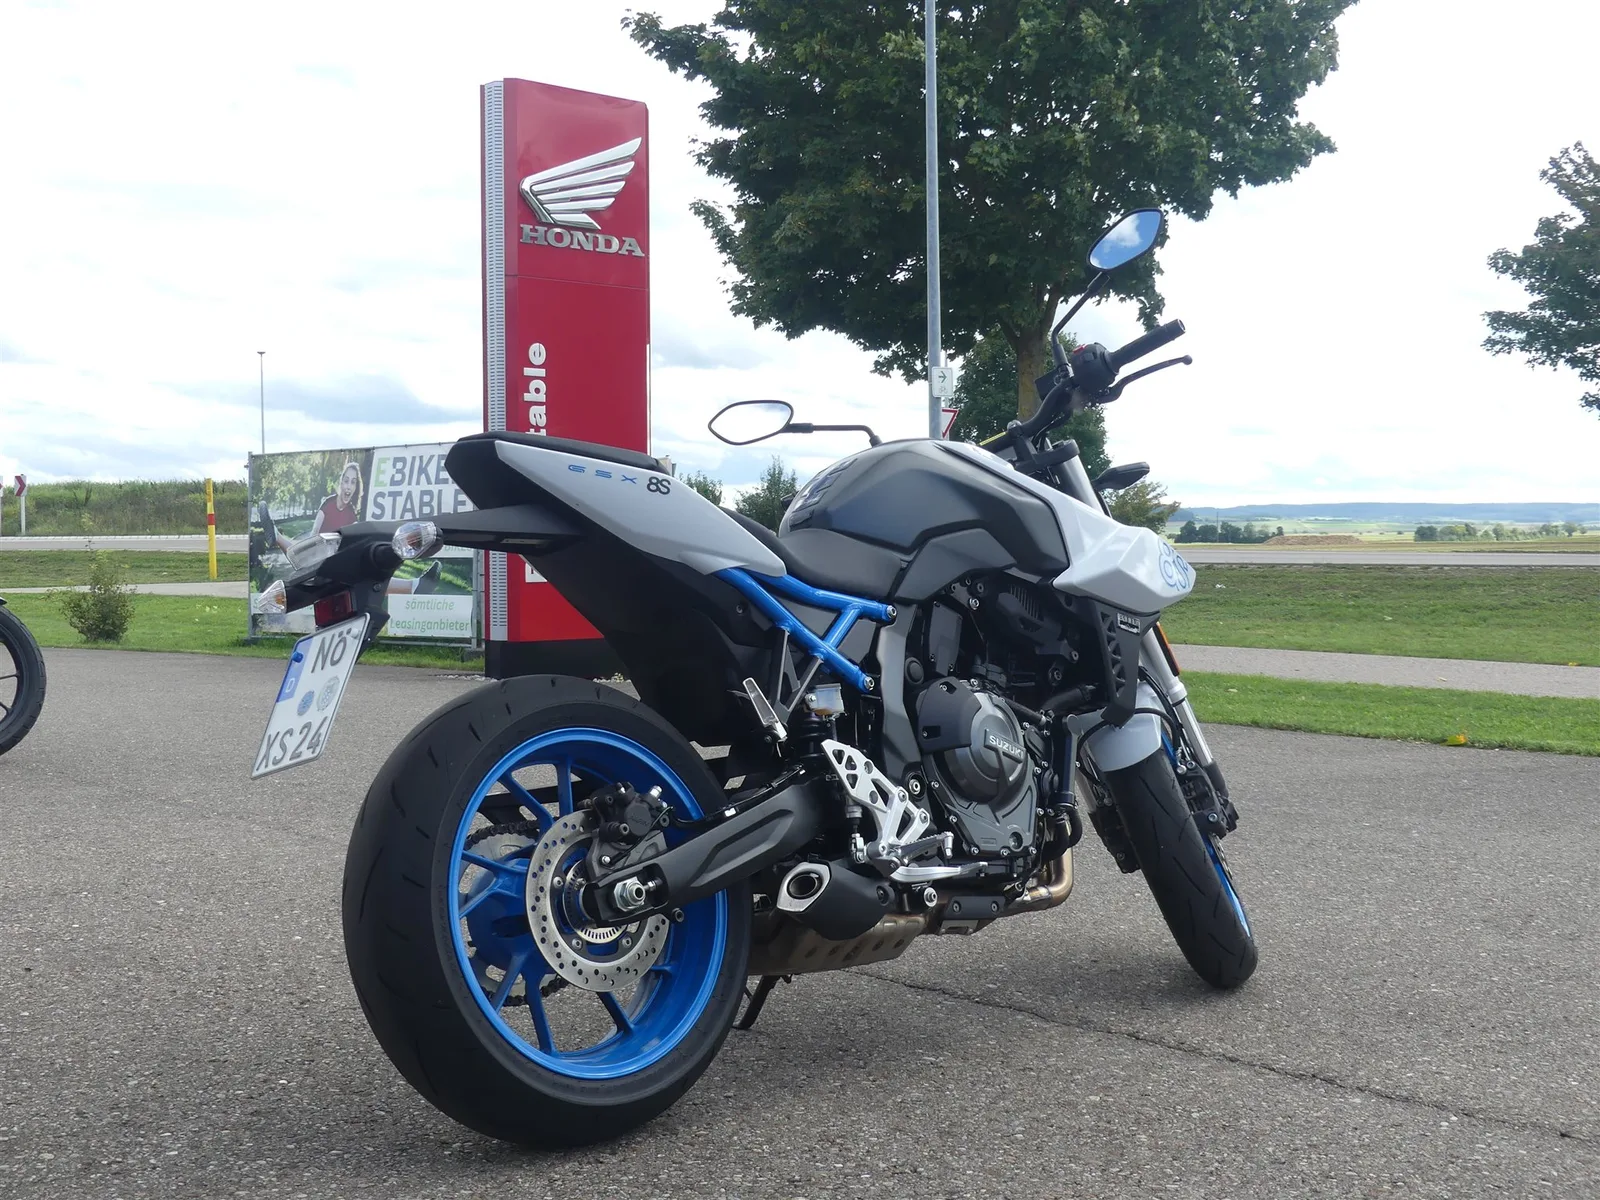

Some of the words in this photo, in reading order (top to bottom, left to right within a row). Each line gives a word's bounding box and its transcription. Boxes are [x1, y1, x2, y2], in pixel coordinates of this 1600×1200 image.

[520, 223, 645, 257] HONDA
[374, 454, 457, 487] EBIKE
[568, 464, 637, 485] GSX
[646, 476, 671, 495] 8S
[371, 488, 467, 520] STABLE
[405, 599, 455, 611] sämtliche
[311, 628, 352, 673] NÖ
[989, 735, 1024, 760] SUZUKI
